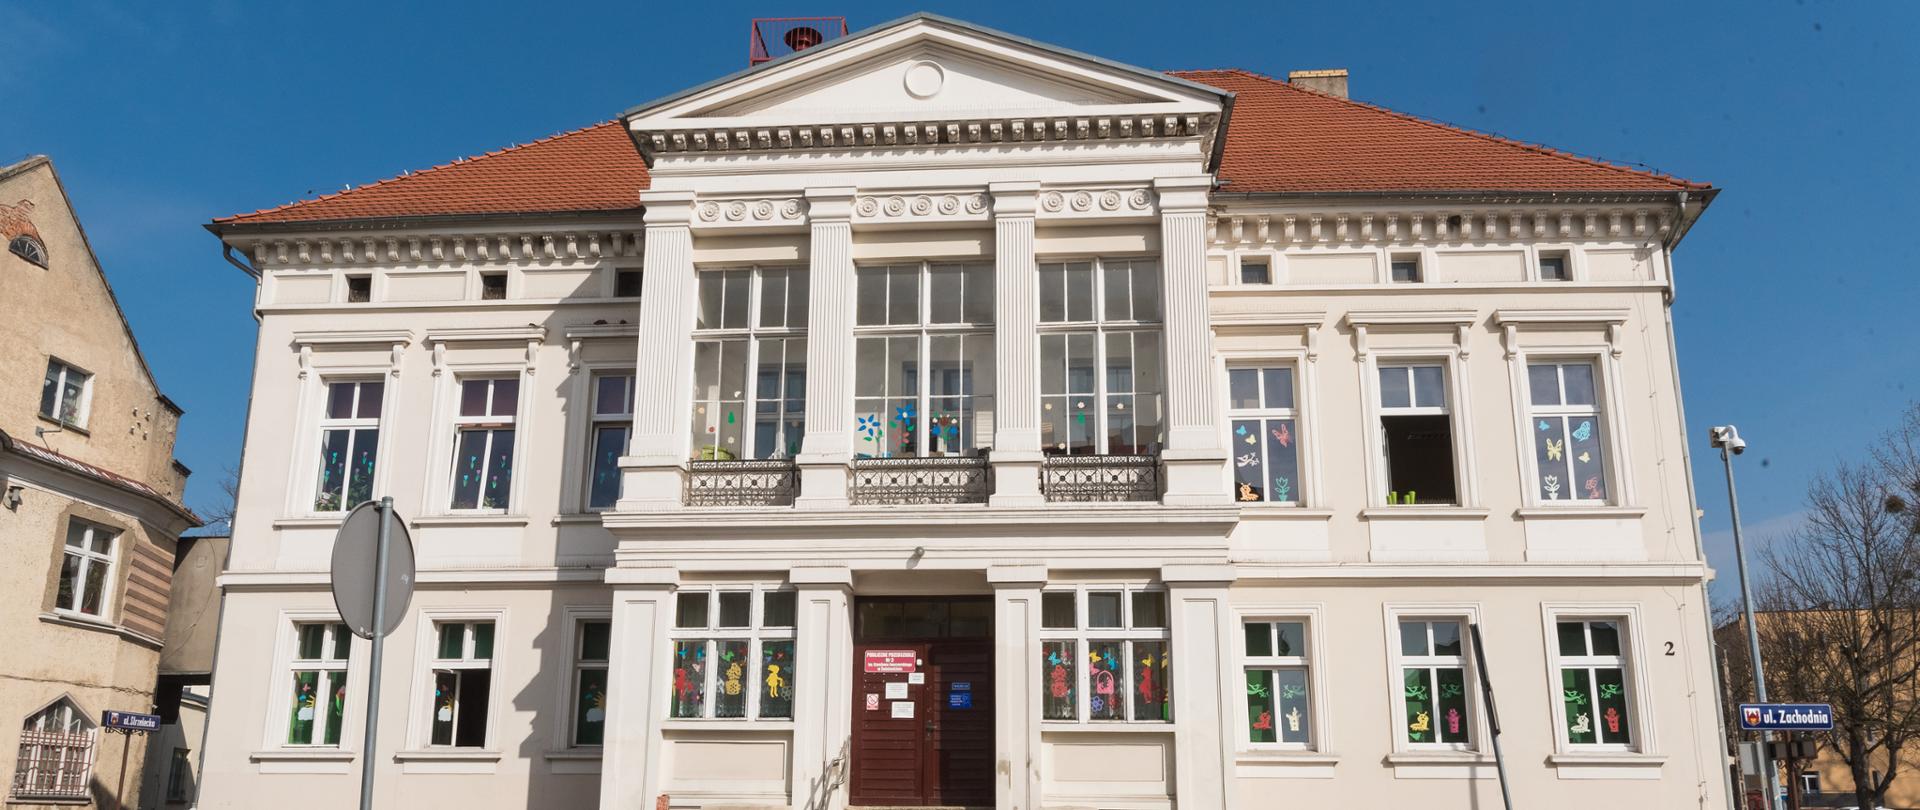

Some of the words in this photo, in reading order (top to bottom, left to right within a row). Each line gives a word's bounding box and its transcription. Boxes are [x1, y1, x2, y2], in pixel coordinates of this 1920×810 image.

[1664, 641, 1675, 656] 2
[1763, 709, 1777, 724] ul.
[1778, 709, 1829, 724] Zachodnia
